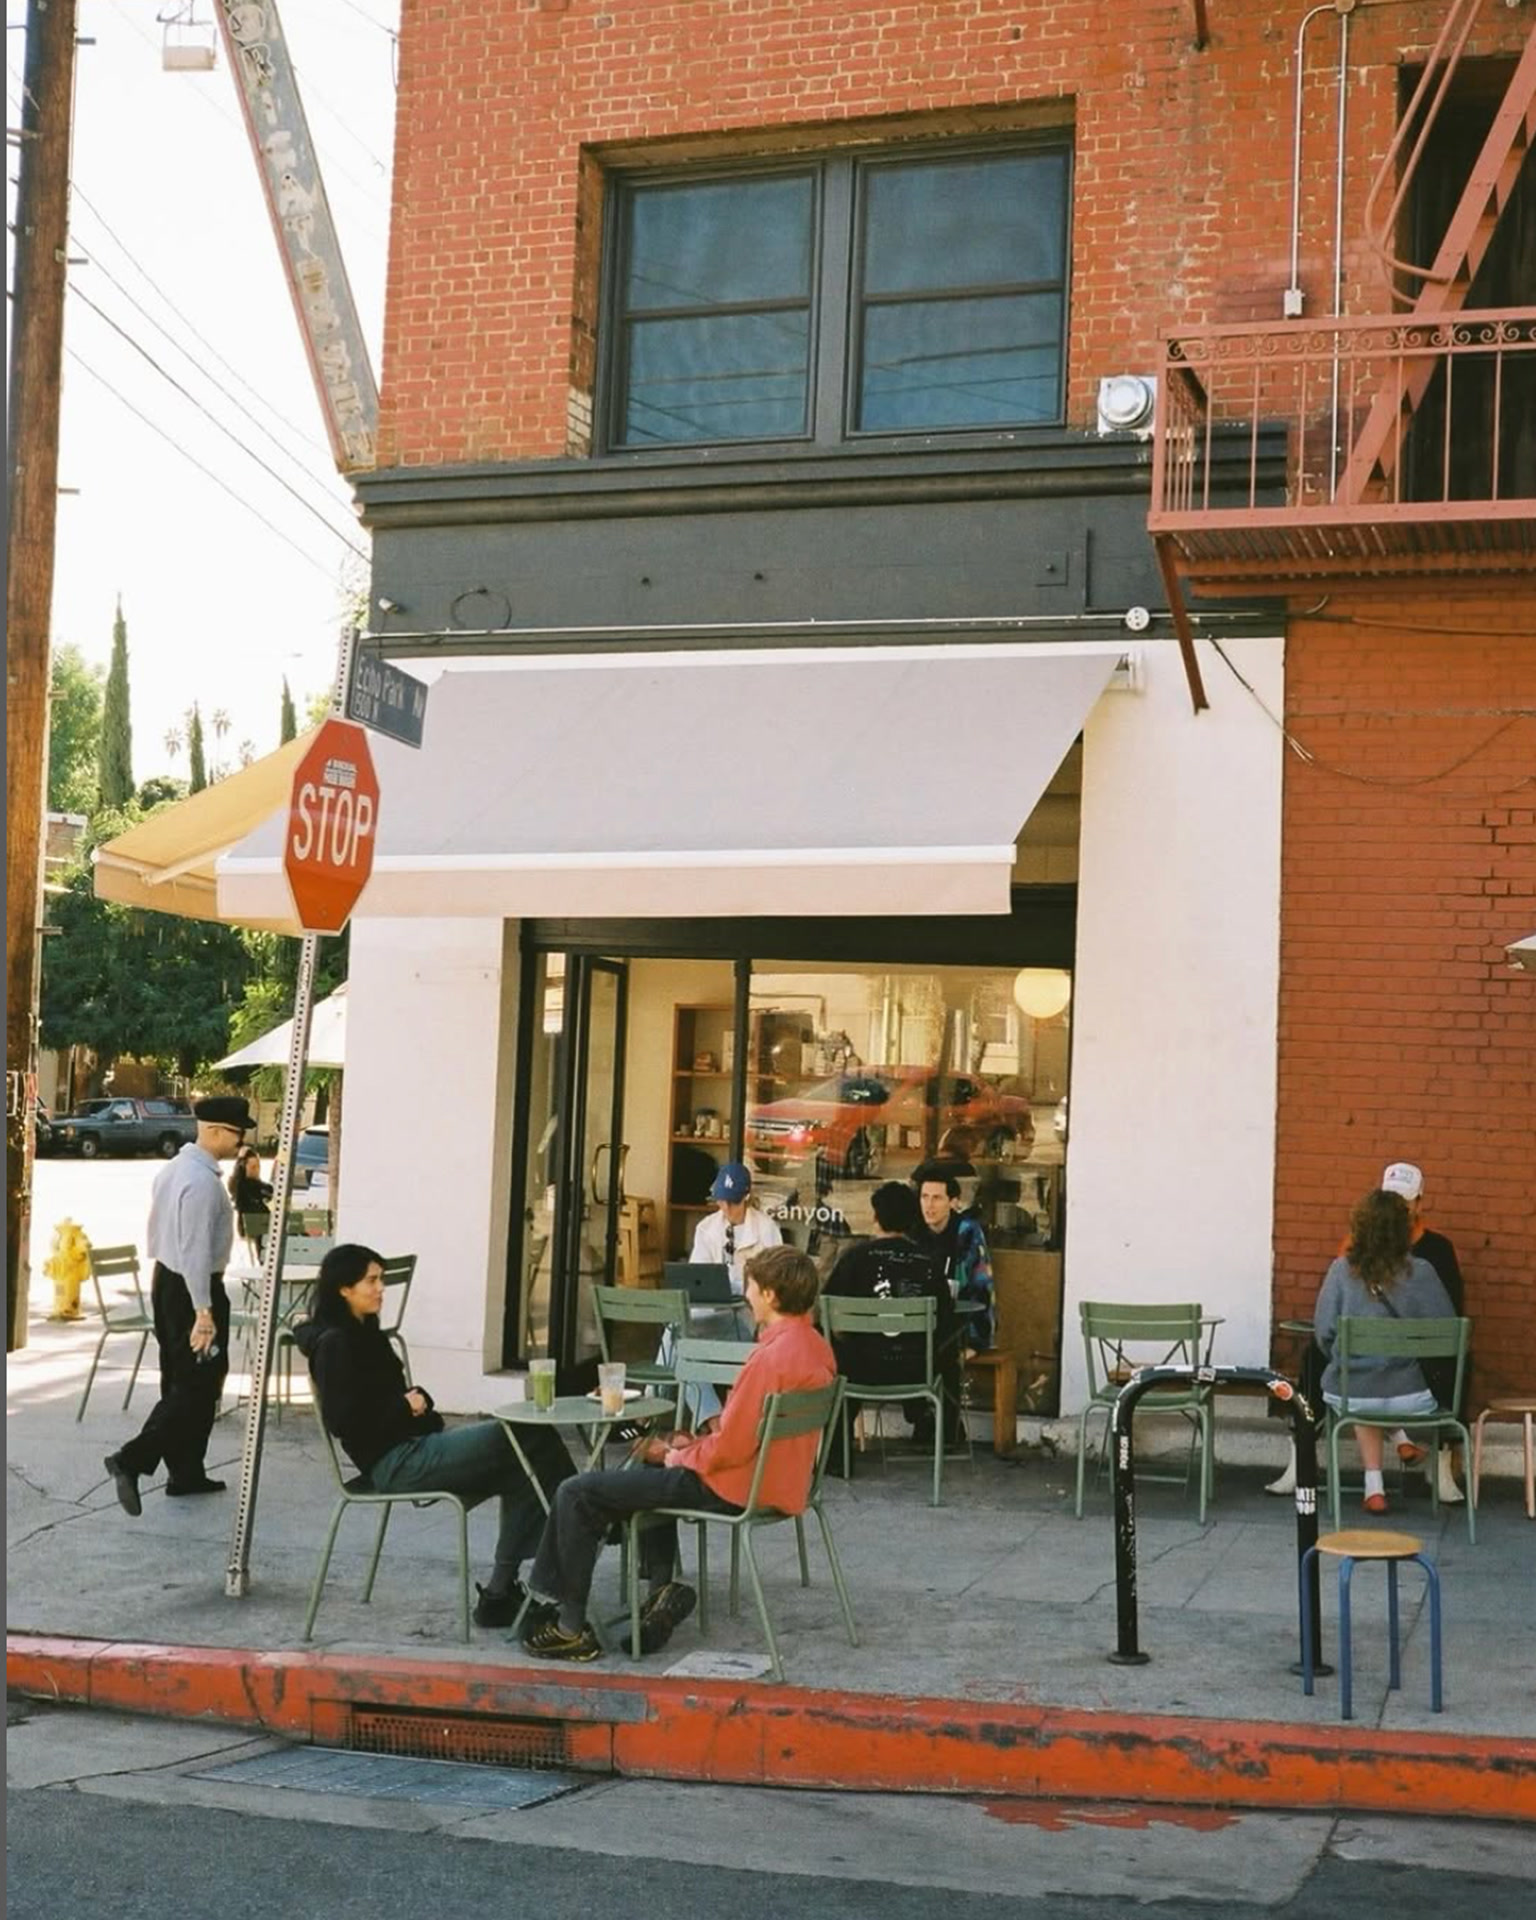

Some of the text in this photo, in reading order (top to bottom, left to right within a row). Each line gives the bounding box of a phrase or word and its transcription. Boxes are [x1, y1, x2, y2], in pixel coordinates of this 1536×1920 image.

[356, 655, 381, 698] Echo
[382, 670, 405, 710] Park
[293, 782, 373, 867] STOP
[764, 1204, 844, 1226] canyon
